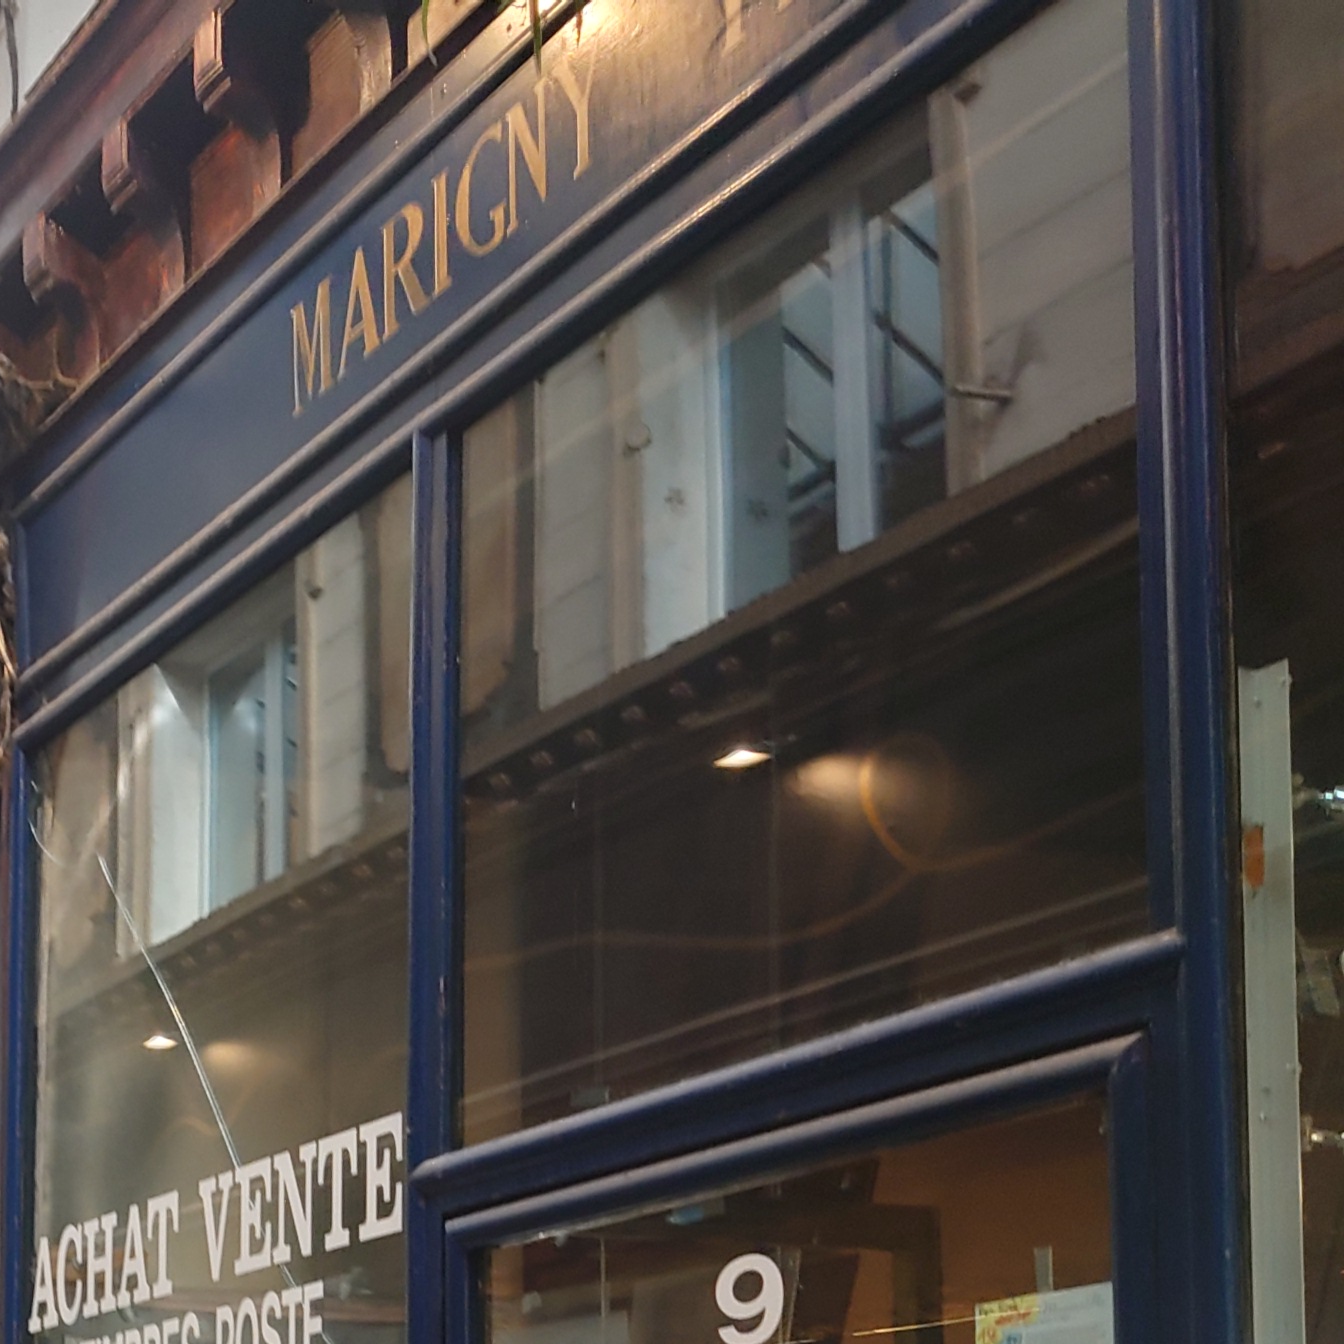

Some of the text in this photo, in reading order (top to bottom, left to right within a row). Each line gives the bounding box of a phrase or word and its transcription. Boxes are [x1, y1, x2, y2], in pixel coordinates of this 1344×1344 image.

[291, 40, 595, 417] MARIGNY
[28, 1111, 404, 1334] ACHAT VENTE
